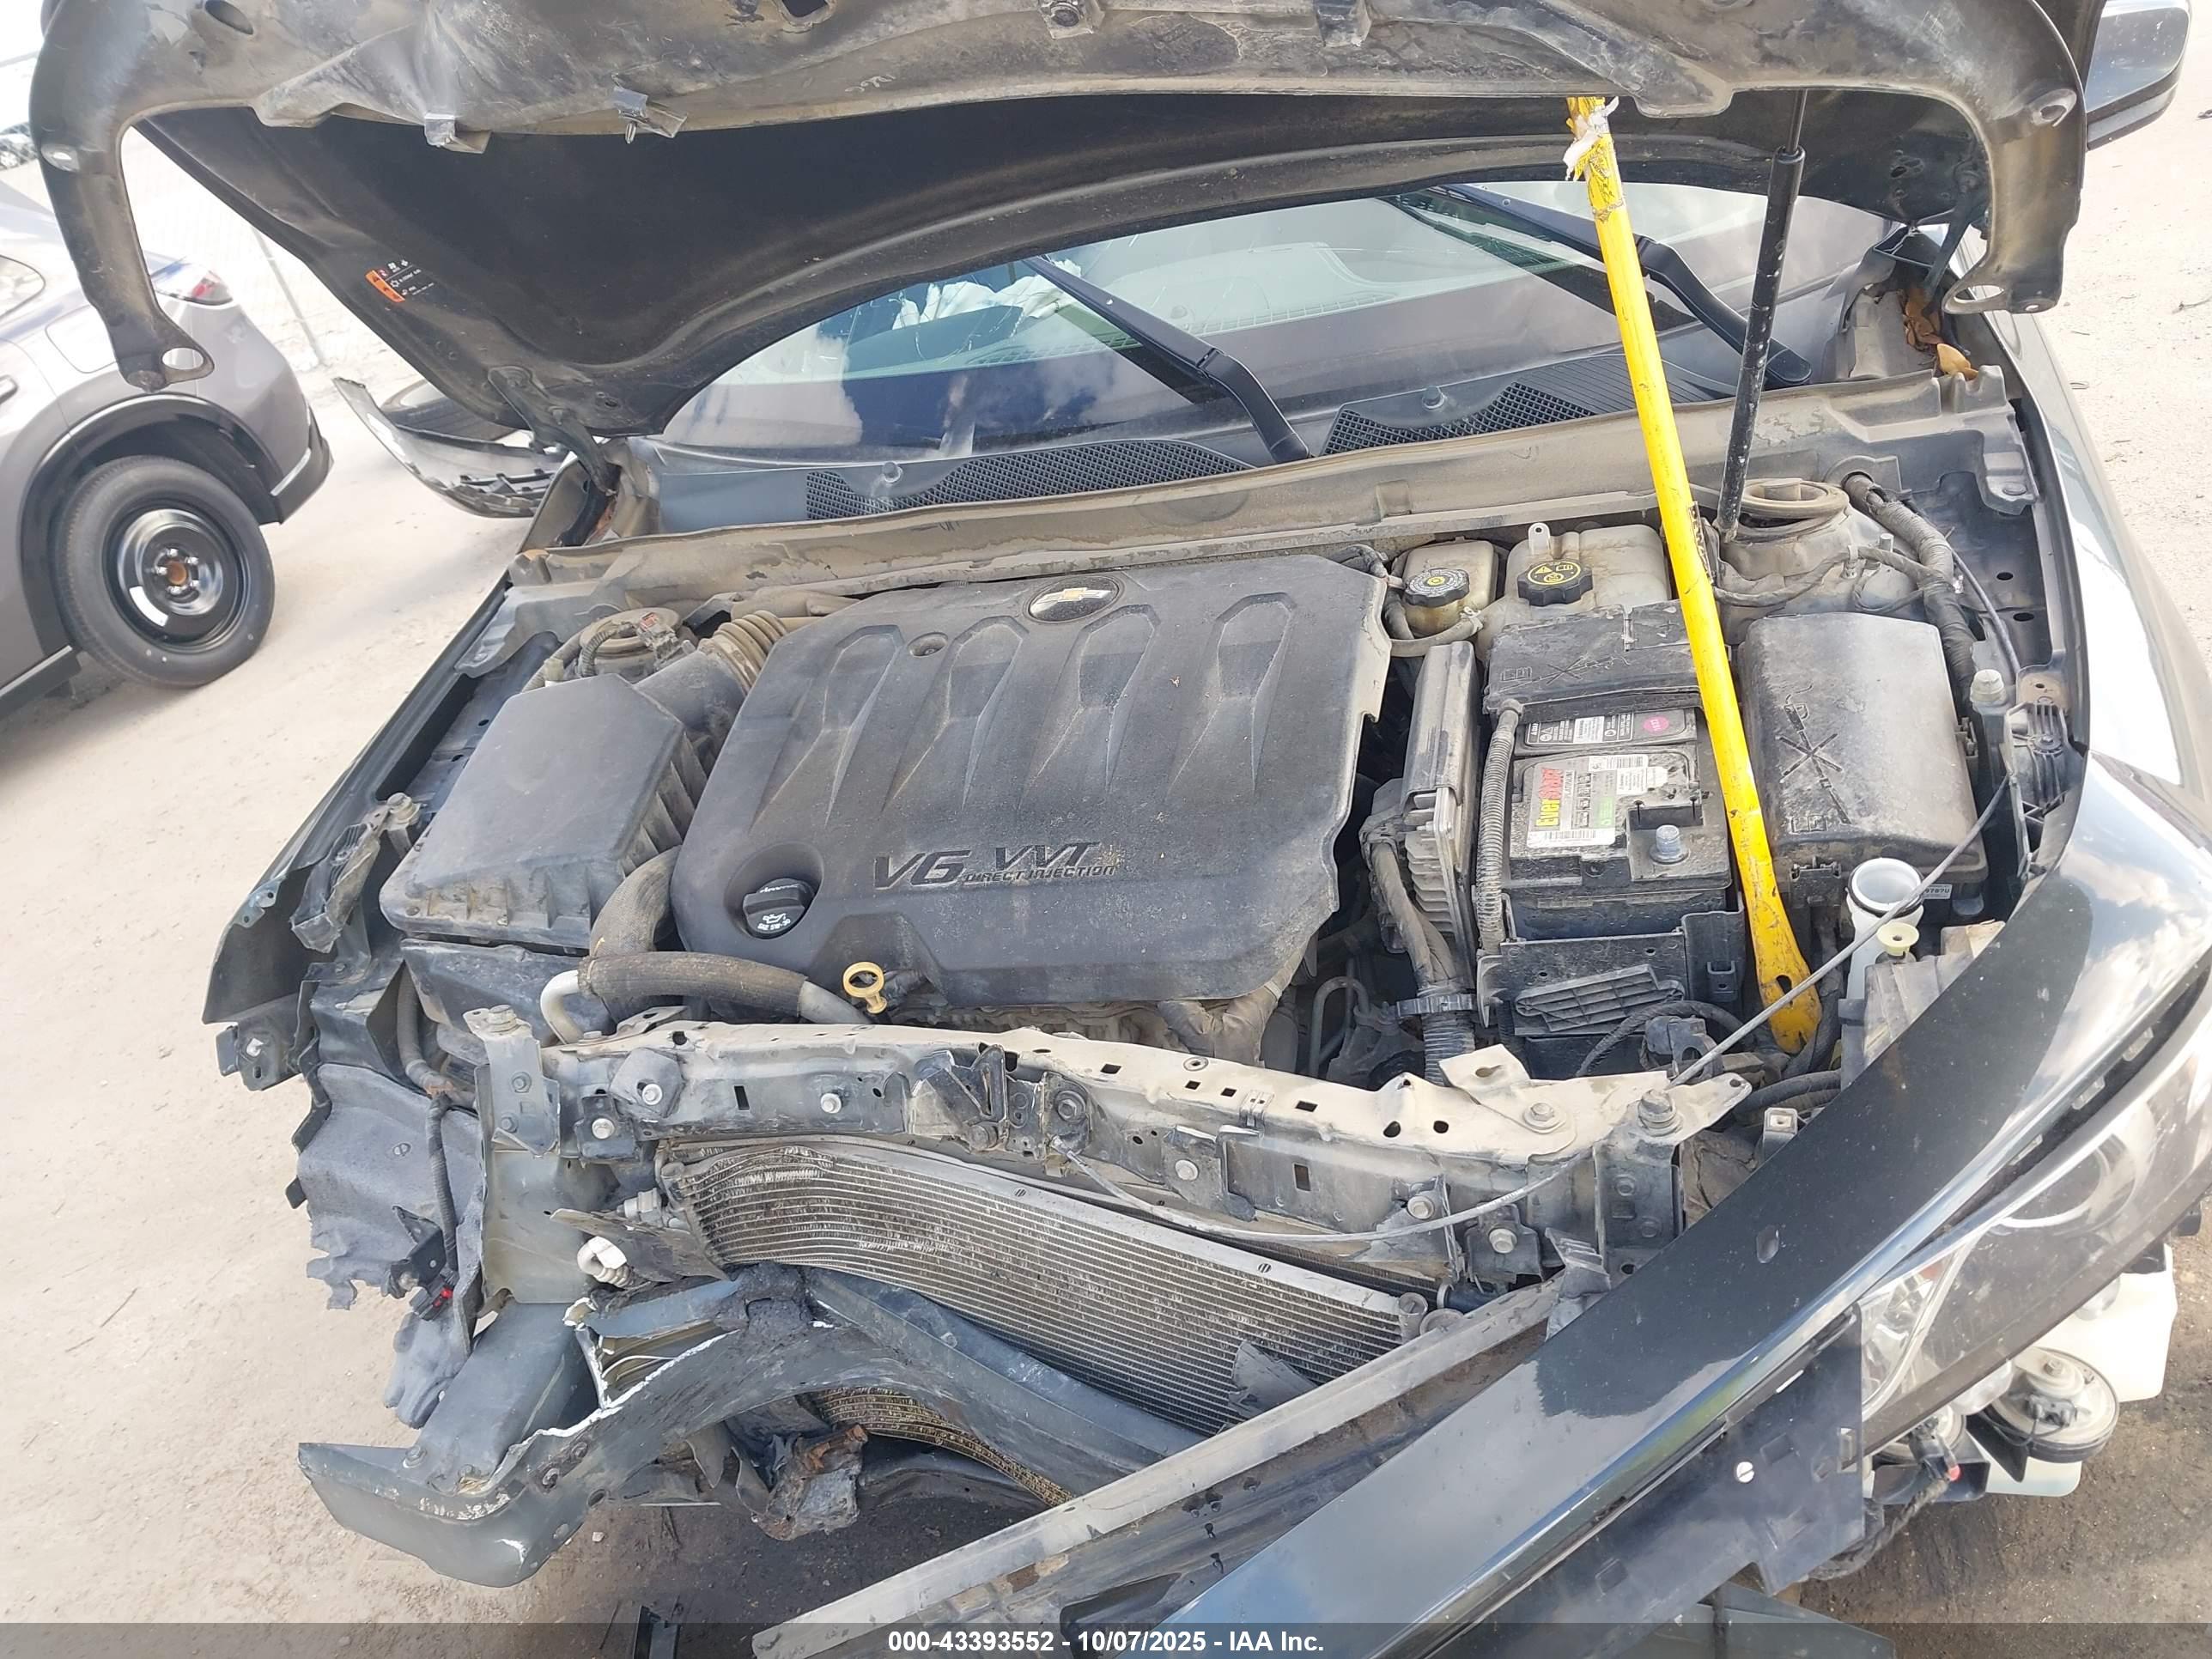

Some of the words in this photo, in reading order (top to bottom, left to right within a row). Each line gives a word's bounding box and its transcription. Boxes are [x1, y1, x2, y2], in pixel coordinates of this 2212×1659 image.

[874, 850, 971, 890] V6
[995, 841, 1101, 871] VVT
[964, 869, 1026, 883] DIRECT
[1027, 865, 1116, 880] INJECTION
